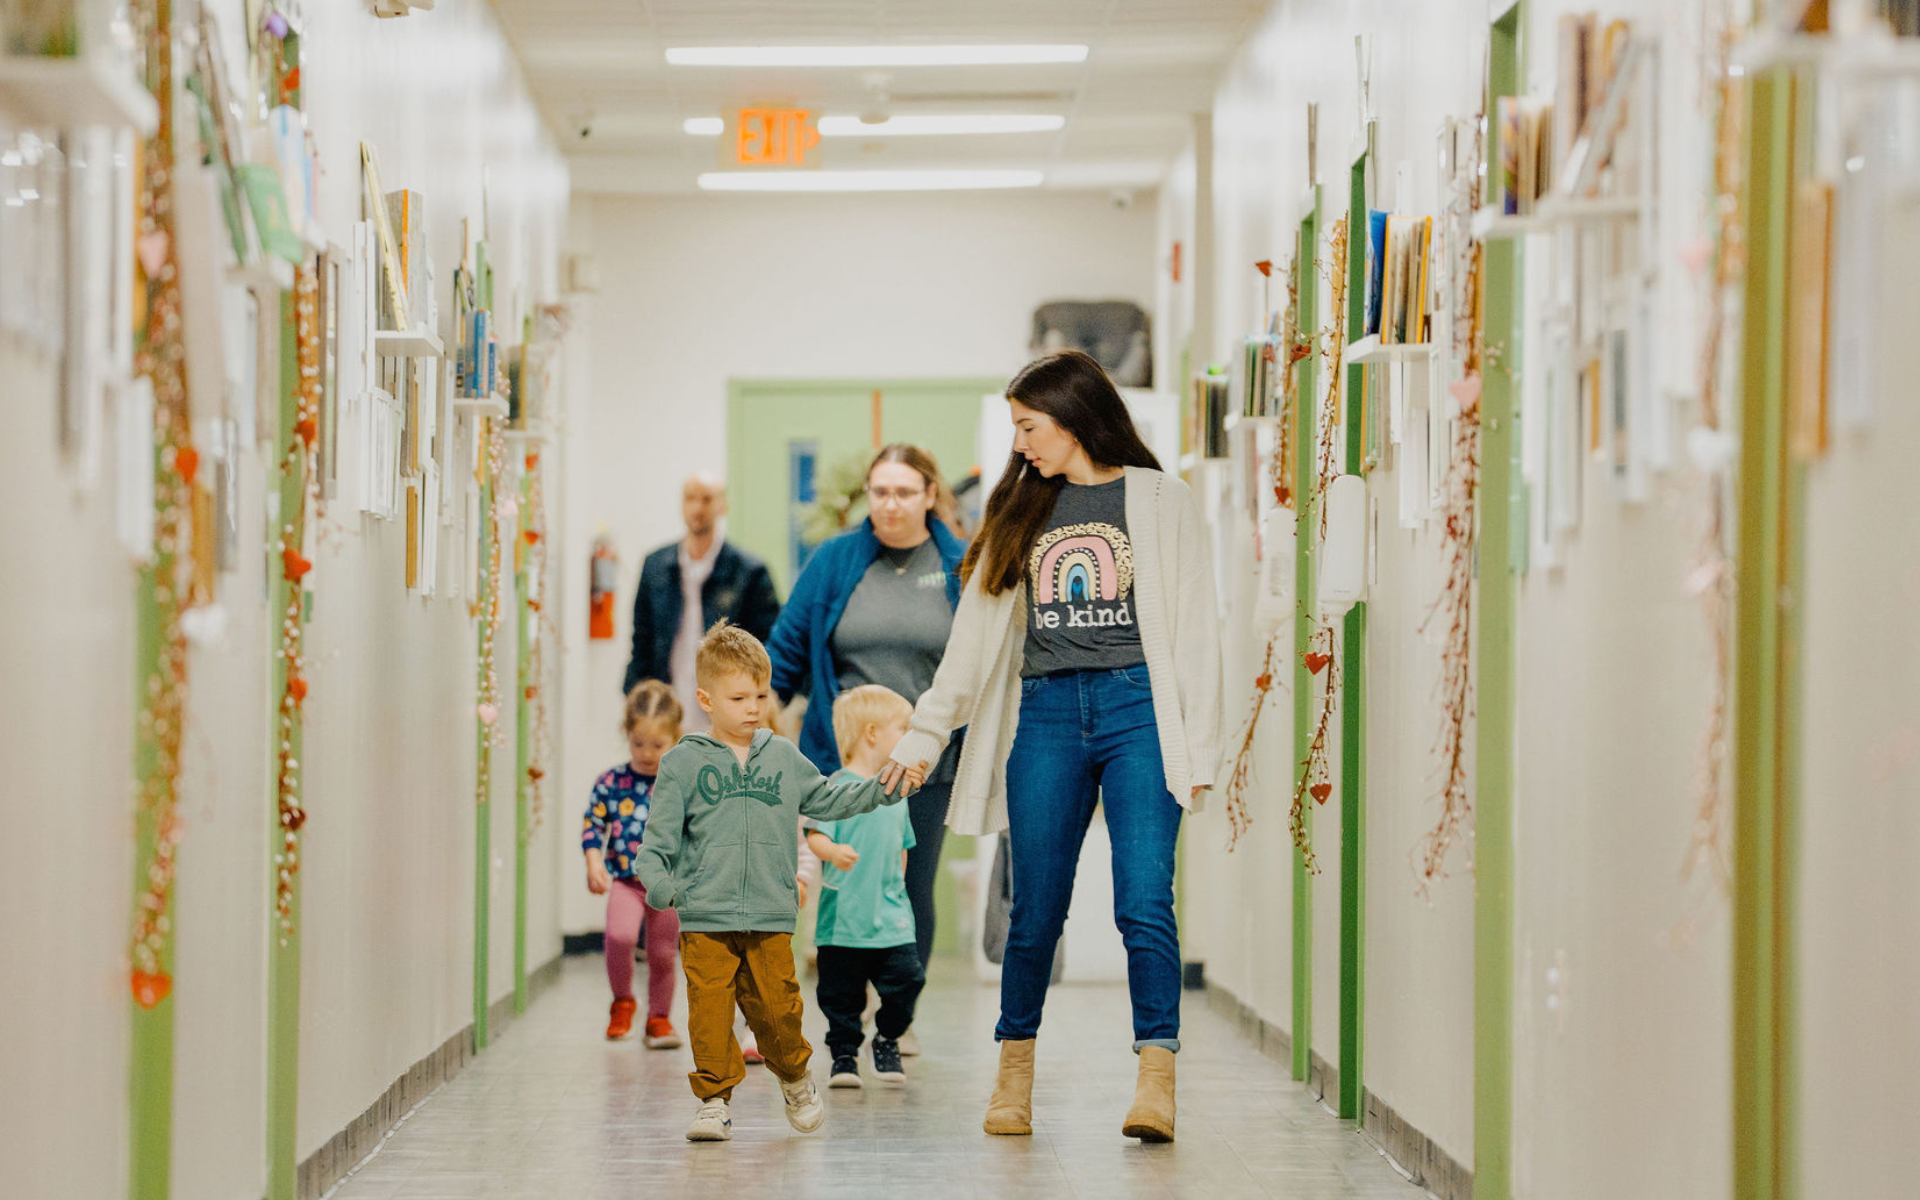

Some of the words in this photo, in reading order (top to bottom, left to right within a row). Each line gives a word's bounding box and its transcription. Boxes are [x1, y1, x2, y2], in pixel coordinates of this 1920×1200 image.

[736, 108, 811, 166] EXIT
[1033, 607, 1060, 629] be
[1066, 603, 1133, 627] kind
